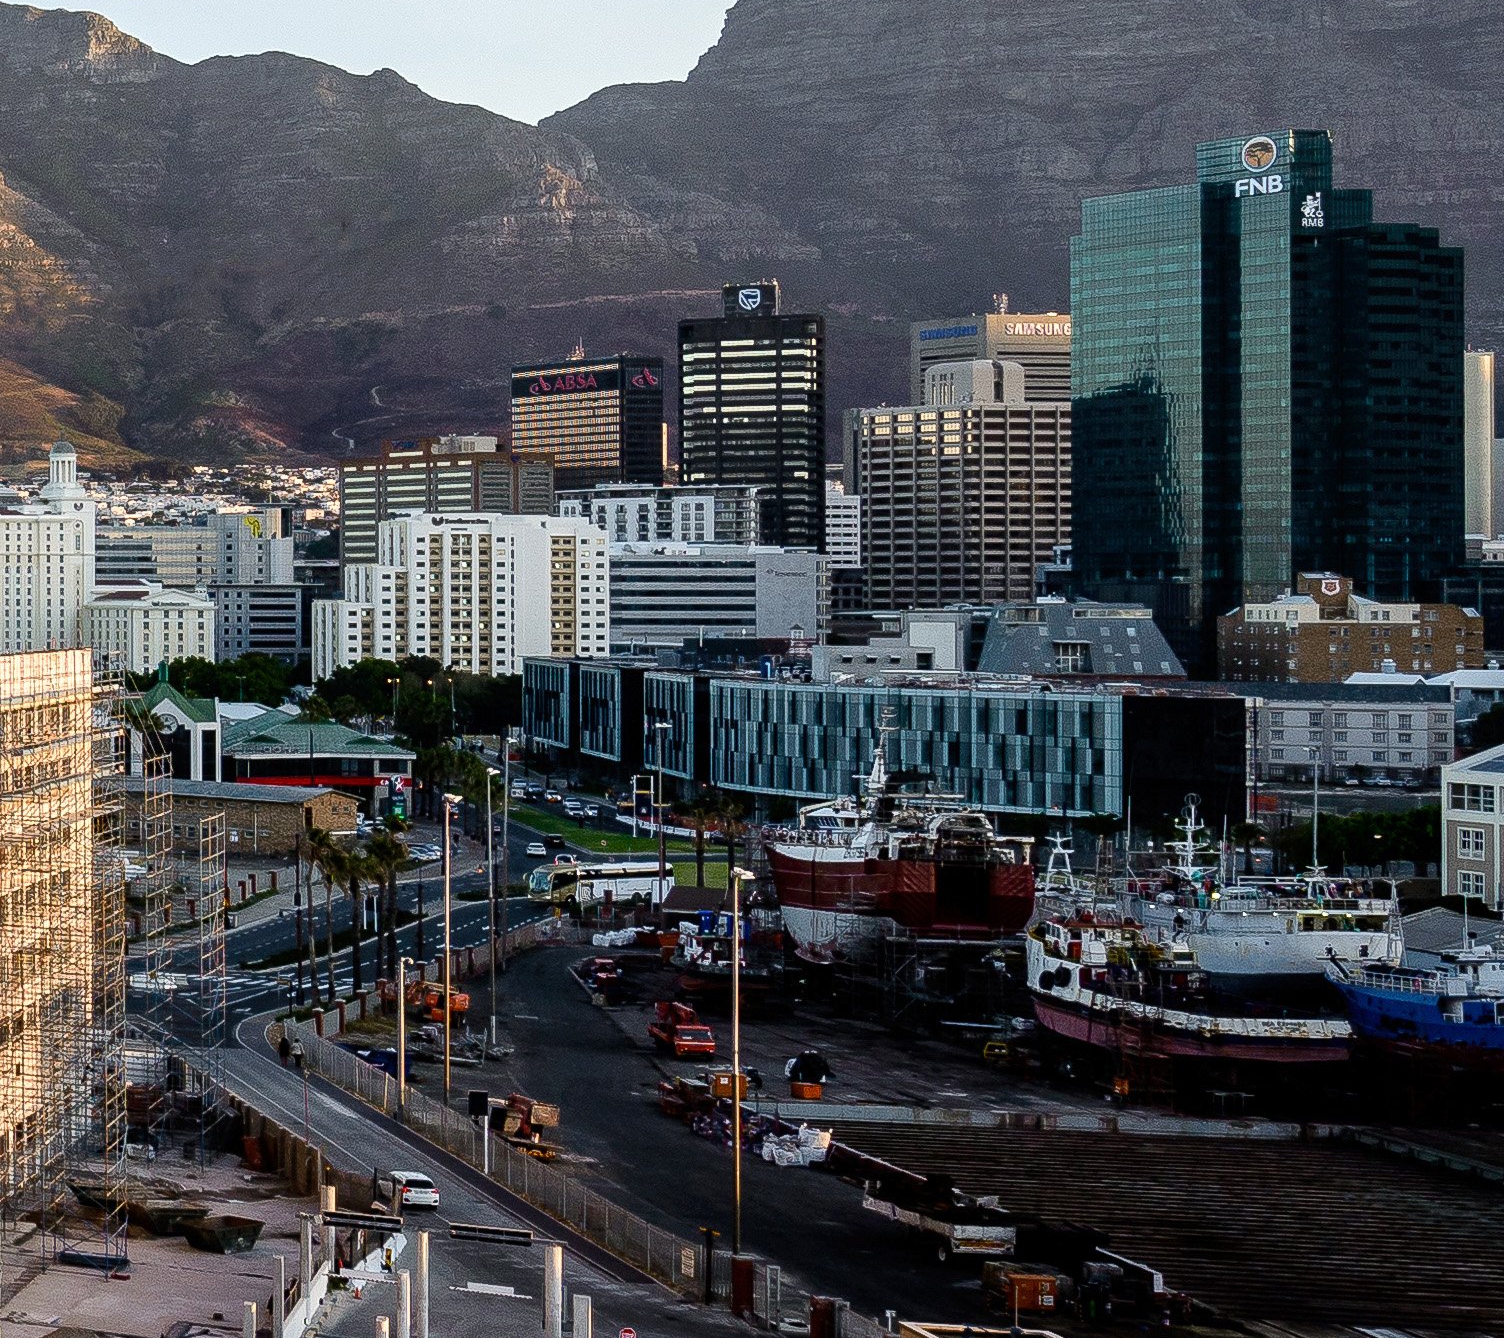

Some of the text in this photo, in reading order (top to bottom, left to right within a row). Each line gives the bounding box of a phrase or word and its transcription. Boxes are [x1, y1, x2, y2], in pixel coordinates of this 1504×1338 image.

[1235, 174, 1284, 198] FNB
[1301, 218, 1325, 228] RMB
[1005, 322, 1072, 336] SAMSUNG
[553, 373, 598, 391] ABSA
